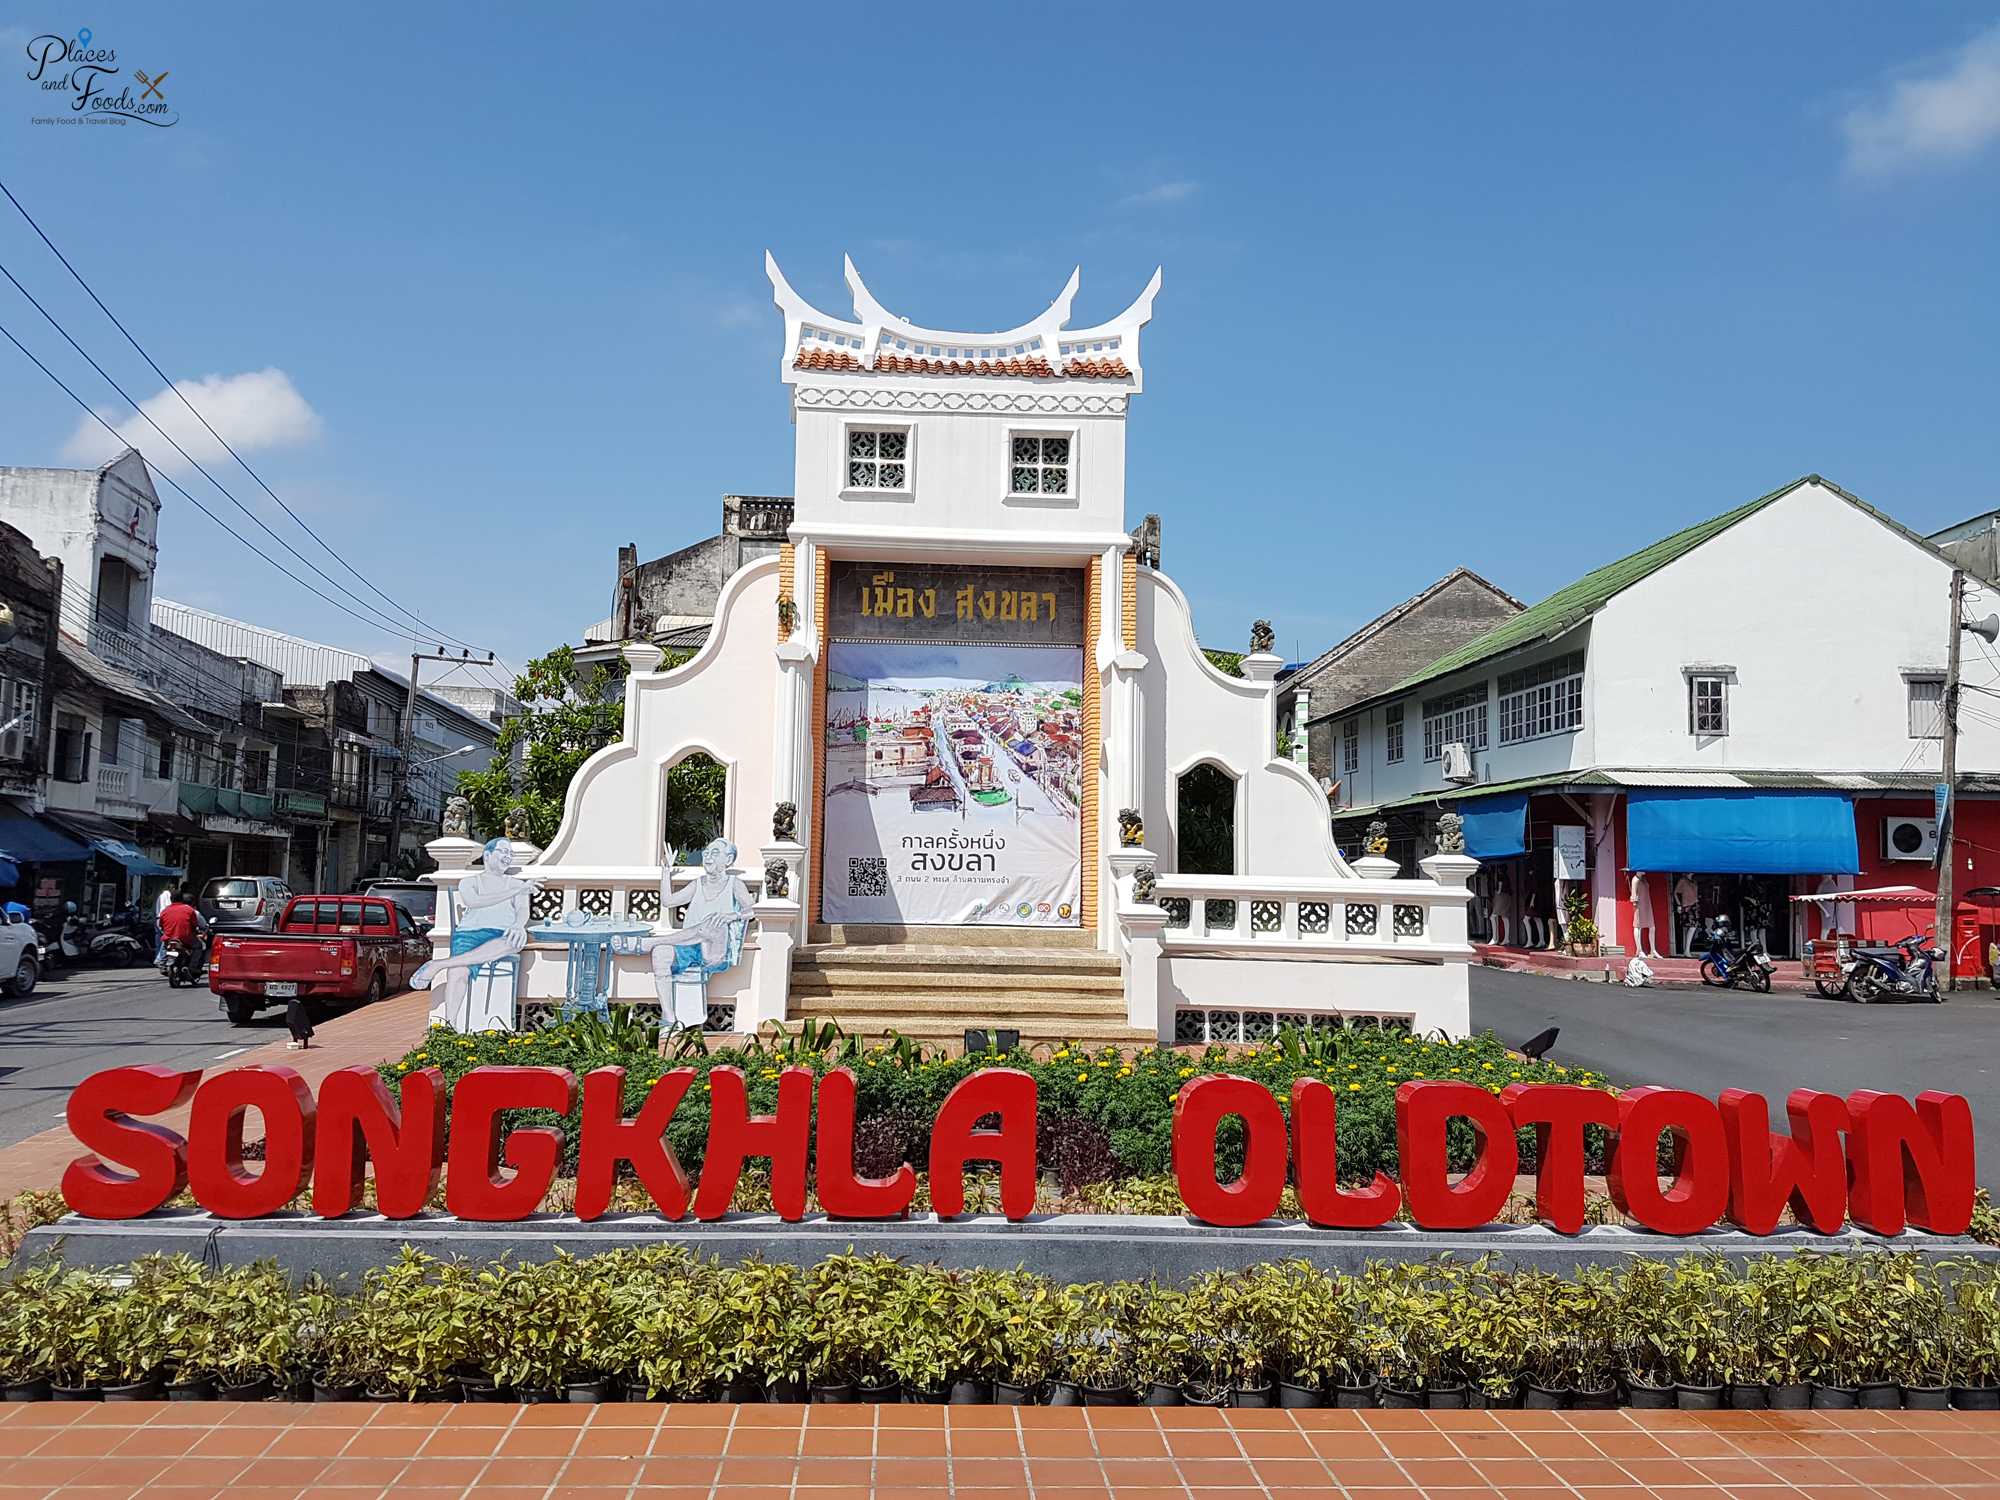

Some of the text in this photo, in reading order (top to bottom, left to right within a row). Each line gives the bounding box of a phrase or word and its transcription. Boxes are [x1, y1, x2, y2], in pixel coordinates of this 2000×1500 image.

[861, 571, 1058, 621] เมือง สงขลา
[901, 828, 1006, 850] กาลครั้งหนึ่ง
[911, 852, 996, 872] สงขลา
[897, 875, 902, 883] 3
[62, 1063, 1976, 1236] SONGKHLA OLDTOWN
